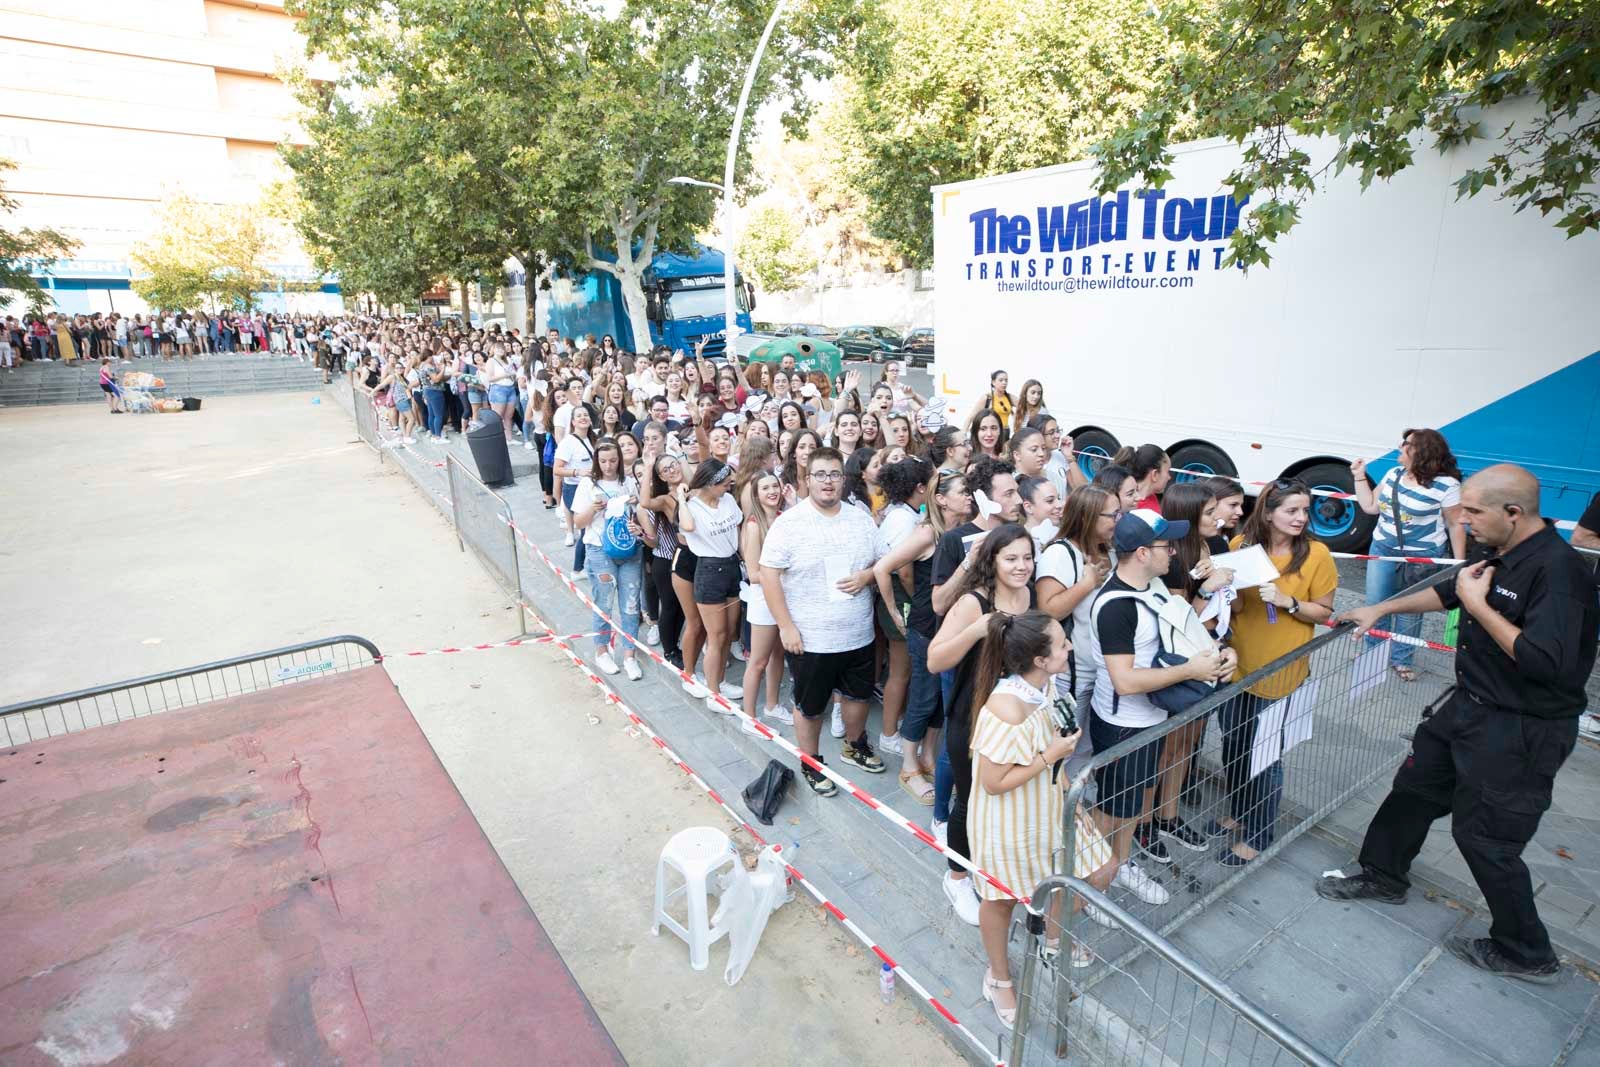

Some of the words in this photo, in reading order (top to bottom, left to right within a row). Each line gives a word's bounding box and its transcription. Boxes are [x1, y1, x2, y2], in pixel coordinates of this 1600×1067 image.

[969, 207, 1032, 256] The
[1037, 189, 1129, 253] Wild
[1137, 188, 1250, 242] Tour
[966, 247, 1248, 281] TRANSPORT-EVENT
[997, 274, 1194, 294] thewildtour@thewildtour.com
